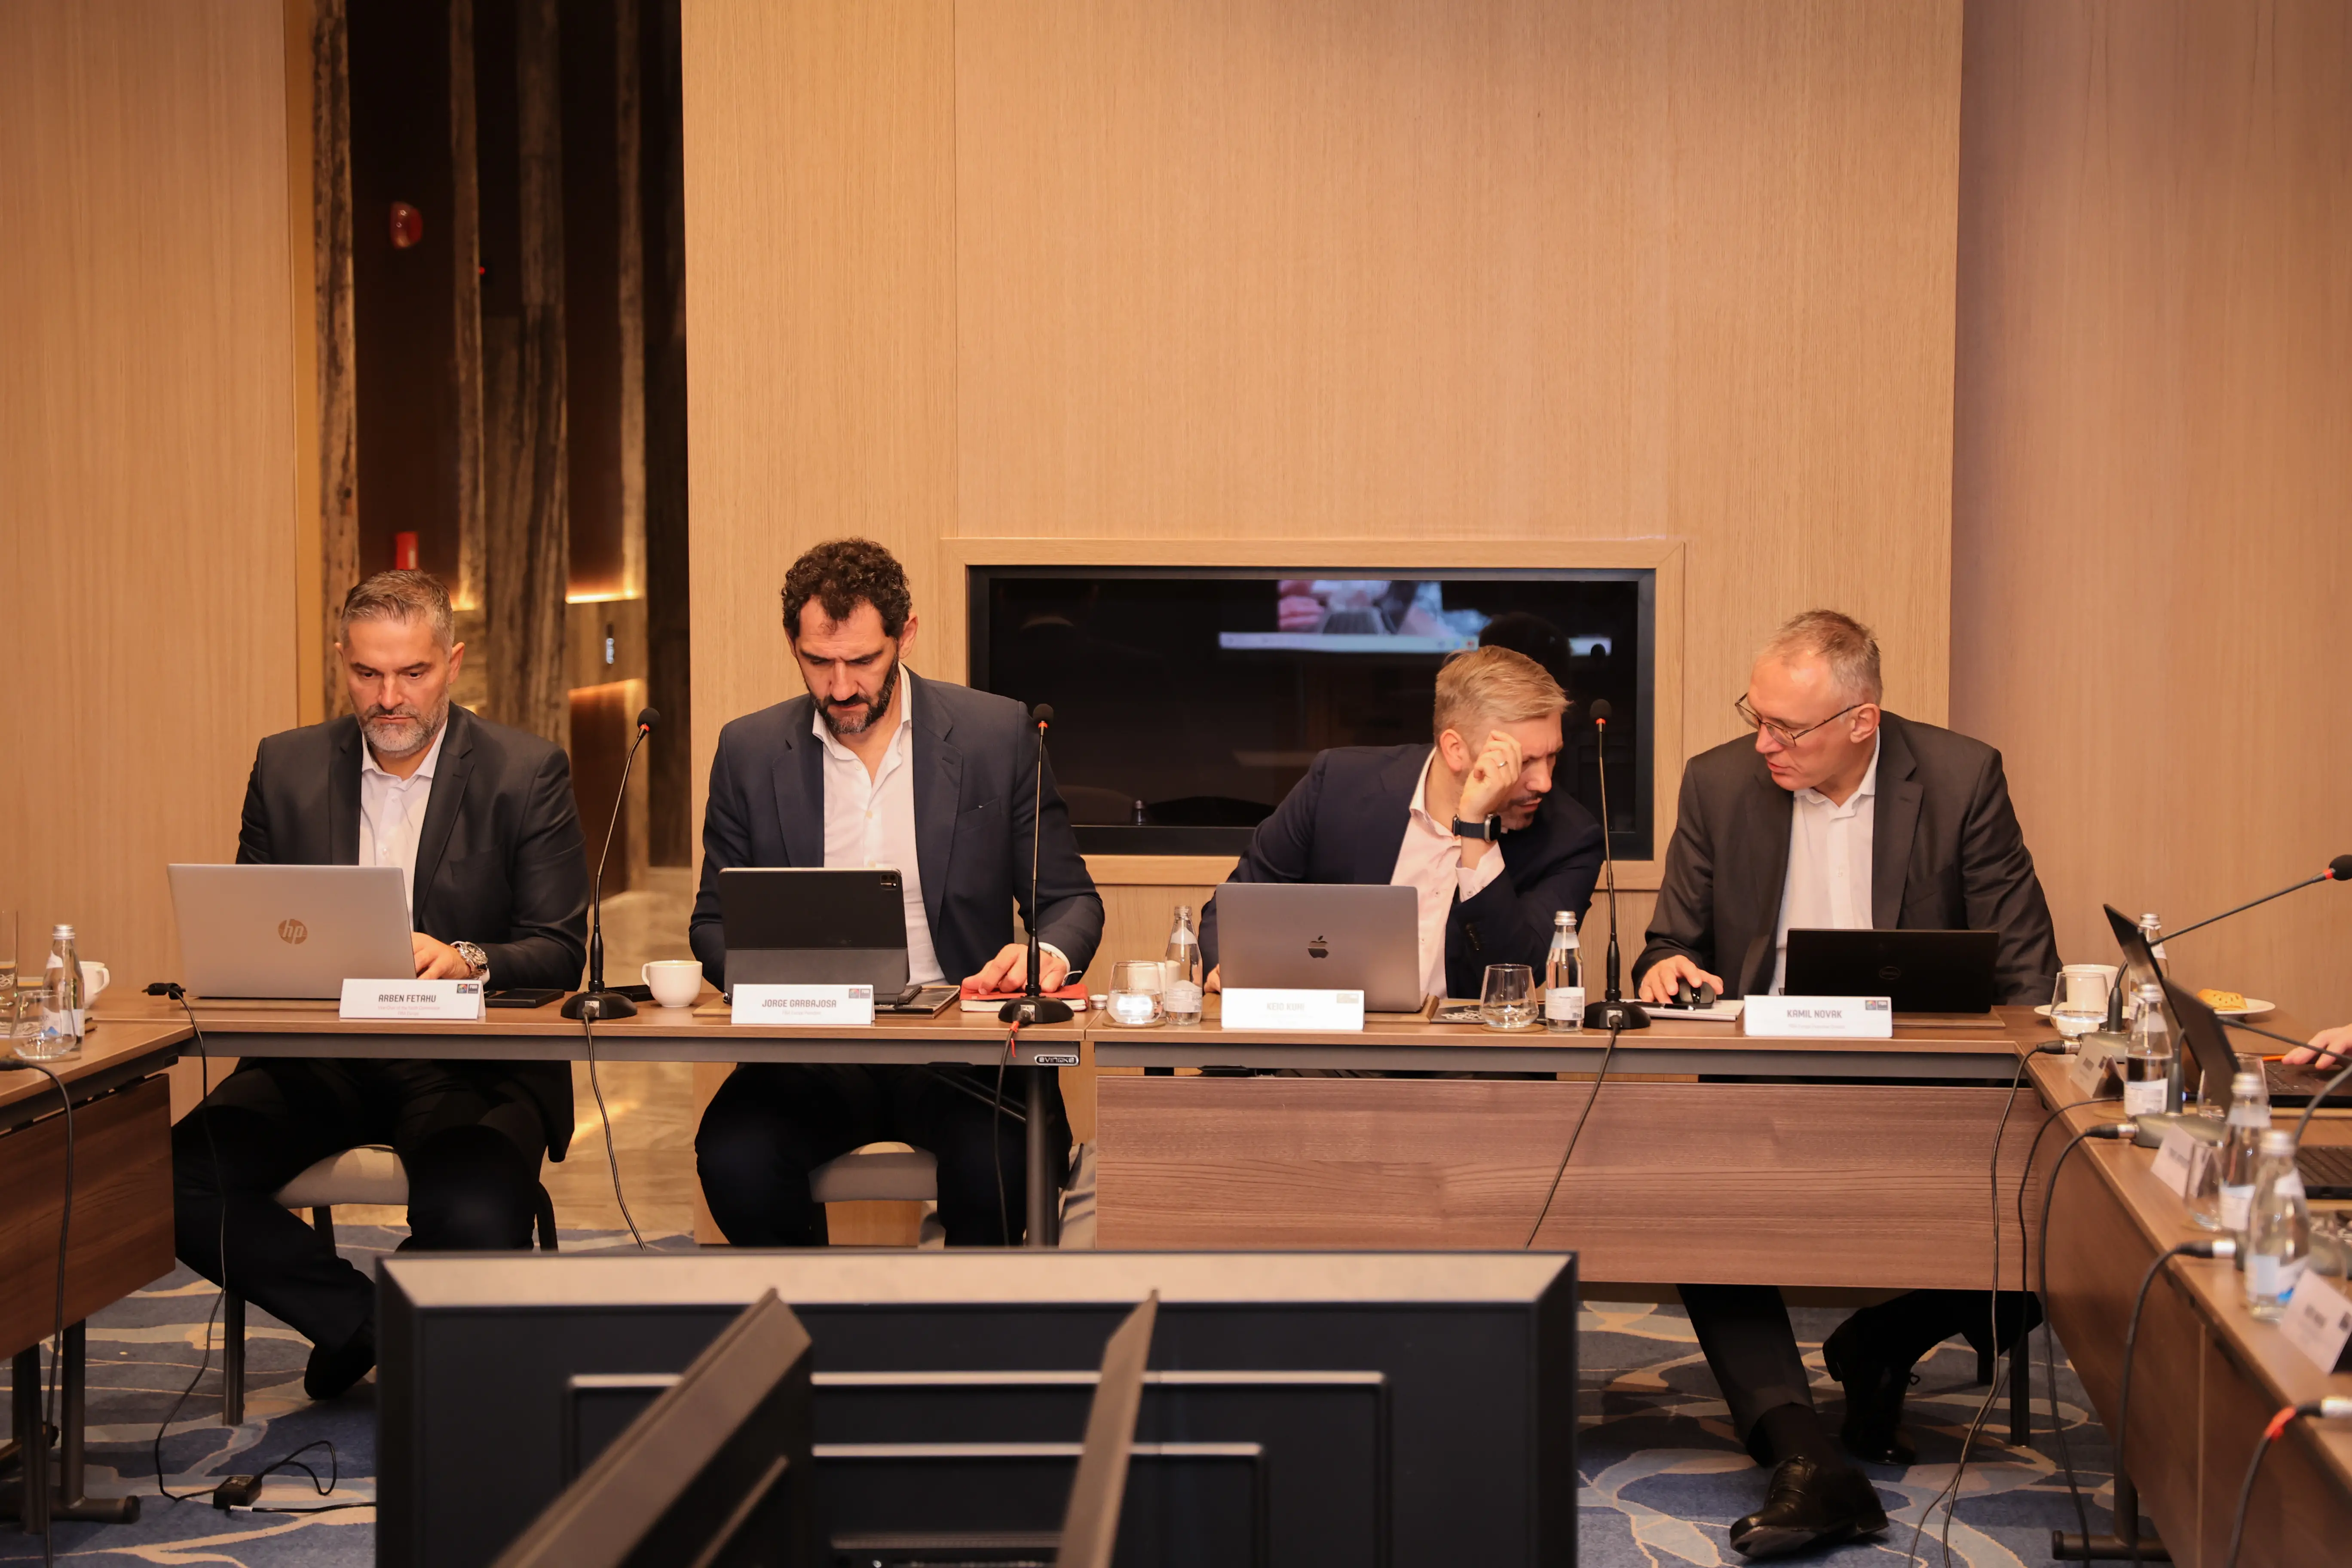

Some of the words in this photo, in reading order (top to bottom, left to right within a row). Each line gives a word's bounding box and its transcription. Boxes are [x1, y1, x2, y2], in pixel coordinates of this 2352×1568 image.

[283, 919, 304, 944] hp
[378, 994, 404, 1002] ARBEN
[406, 995, 436, 1003] FETAHU
[762, 999, 788, 1008] JORGE
[790, 999, 836, 1008] GARBAJOSA
[1787, 1010, 1813, 1018] KAMIL
[1814, 1010, 1843, 1019] NOVAK
